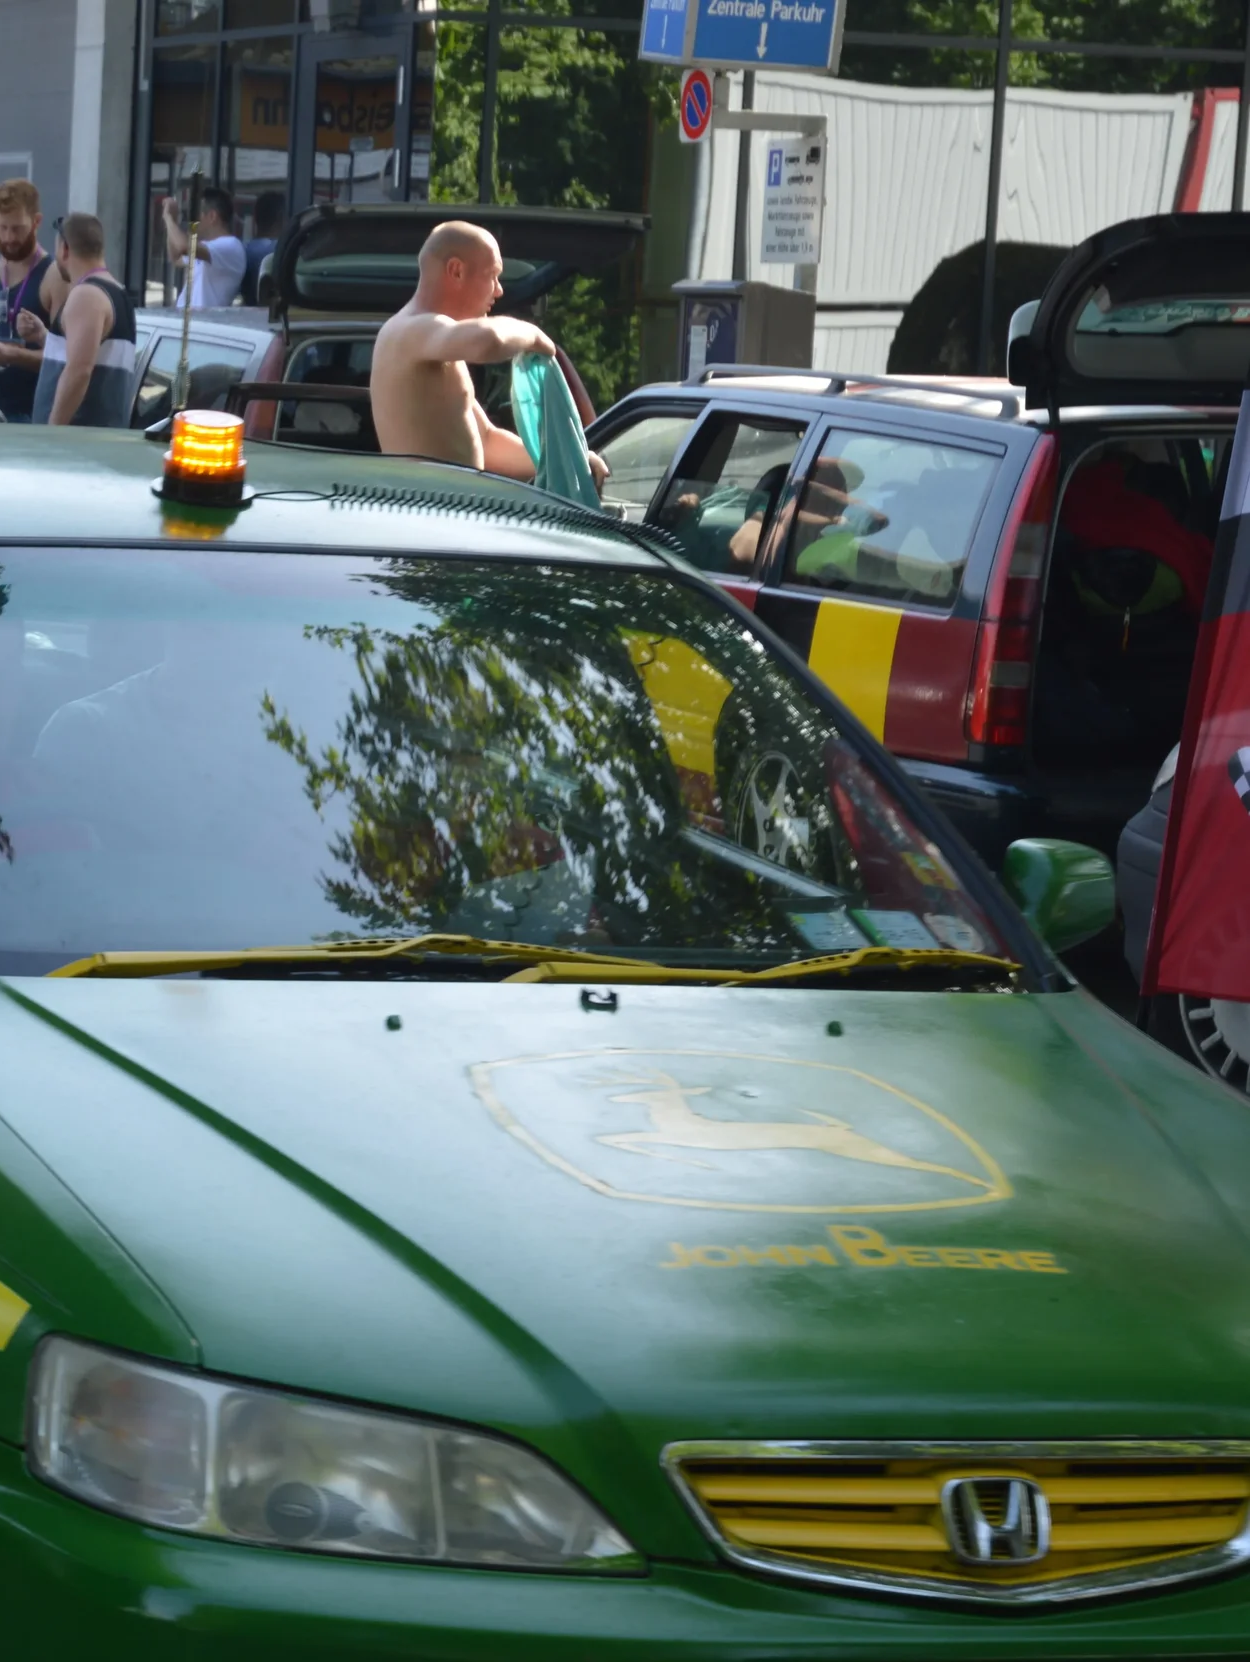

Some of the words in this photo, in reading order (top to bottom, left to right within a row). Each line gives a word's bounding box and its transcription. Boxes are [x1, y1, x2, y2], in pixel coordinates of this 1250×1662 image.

[707, 0, 766, 19] Zentrale
[770, 1, 826, 23] Parkuhr
[660, 1241, 839, 1269] JOHN
